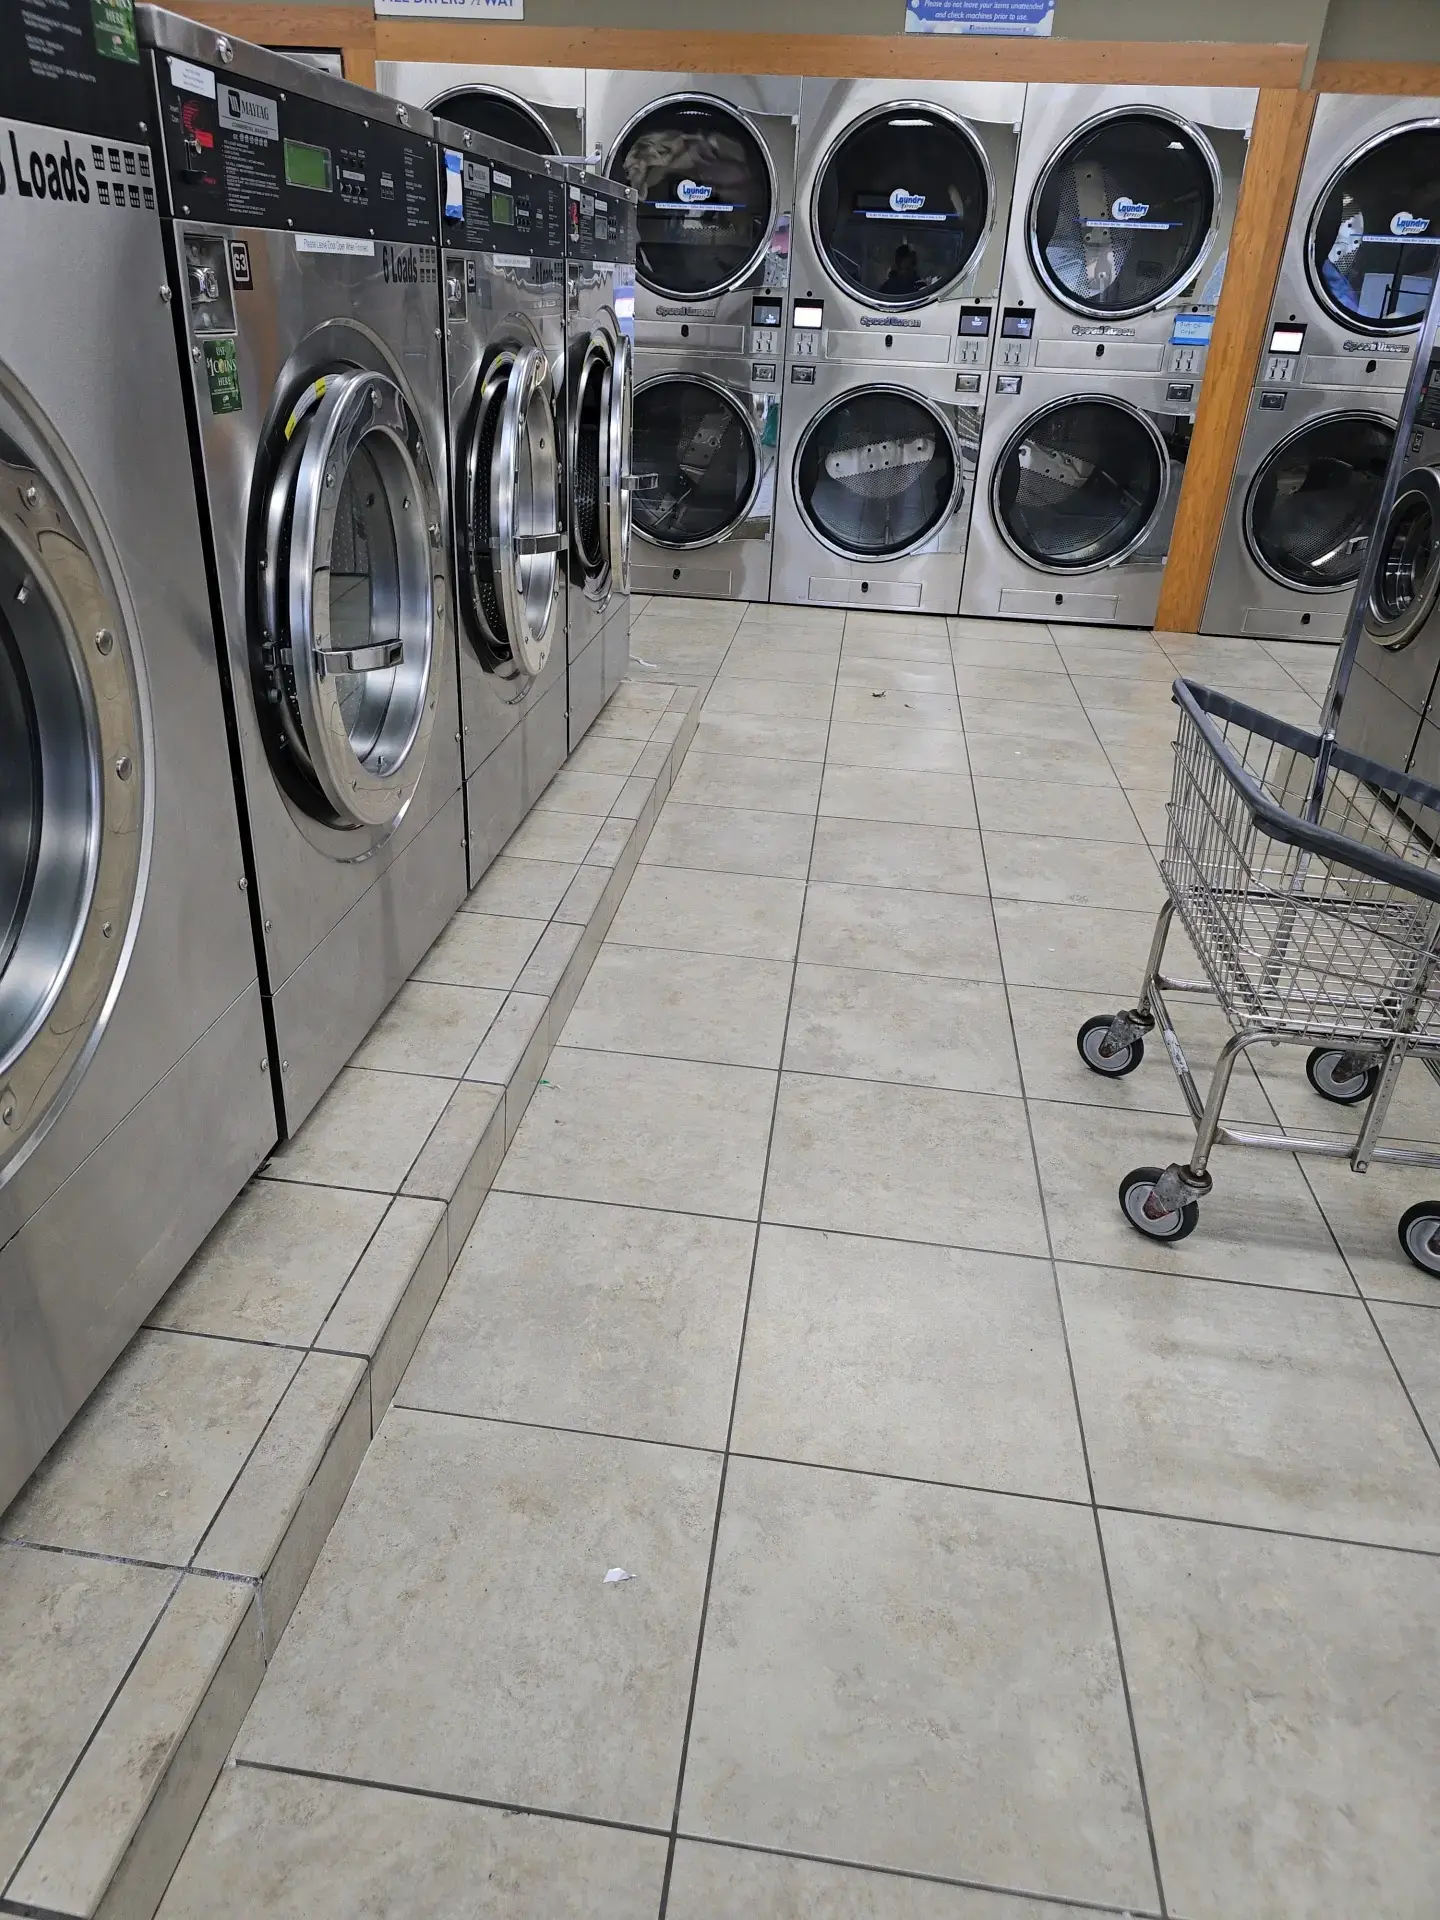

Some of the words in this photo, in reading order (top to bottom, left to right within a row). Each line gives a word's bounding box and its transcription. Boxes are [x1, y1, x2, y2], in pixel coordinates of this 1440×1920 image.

[944, 0, 952, 8] do
[1011, 2, 1044, 10] unattended
[966, 12, 993, 20] machines
[994, 13, 1009, 21] prior
[241, 101, 269, 120] MAYTAG
[8, 130, 90, 204] Loads
[683, 185, 710, 195] Laundry
[895, 194, 924, 204] Laundry
[1118, 202, 1148, 213] Laundry
[1397, 217, 1428, 229] Laundry
[233, 253, 247, 270] 63
[383, 246, 390, 284] 6
[390, 246, 417, 283] Loads
[215, 346, 226, 356] USE
[218, 376, 231, 387] HERE
